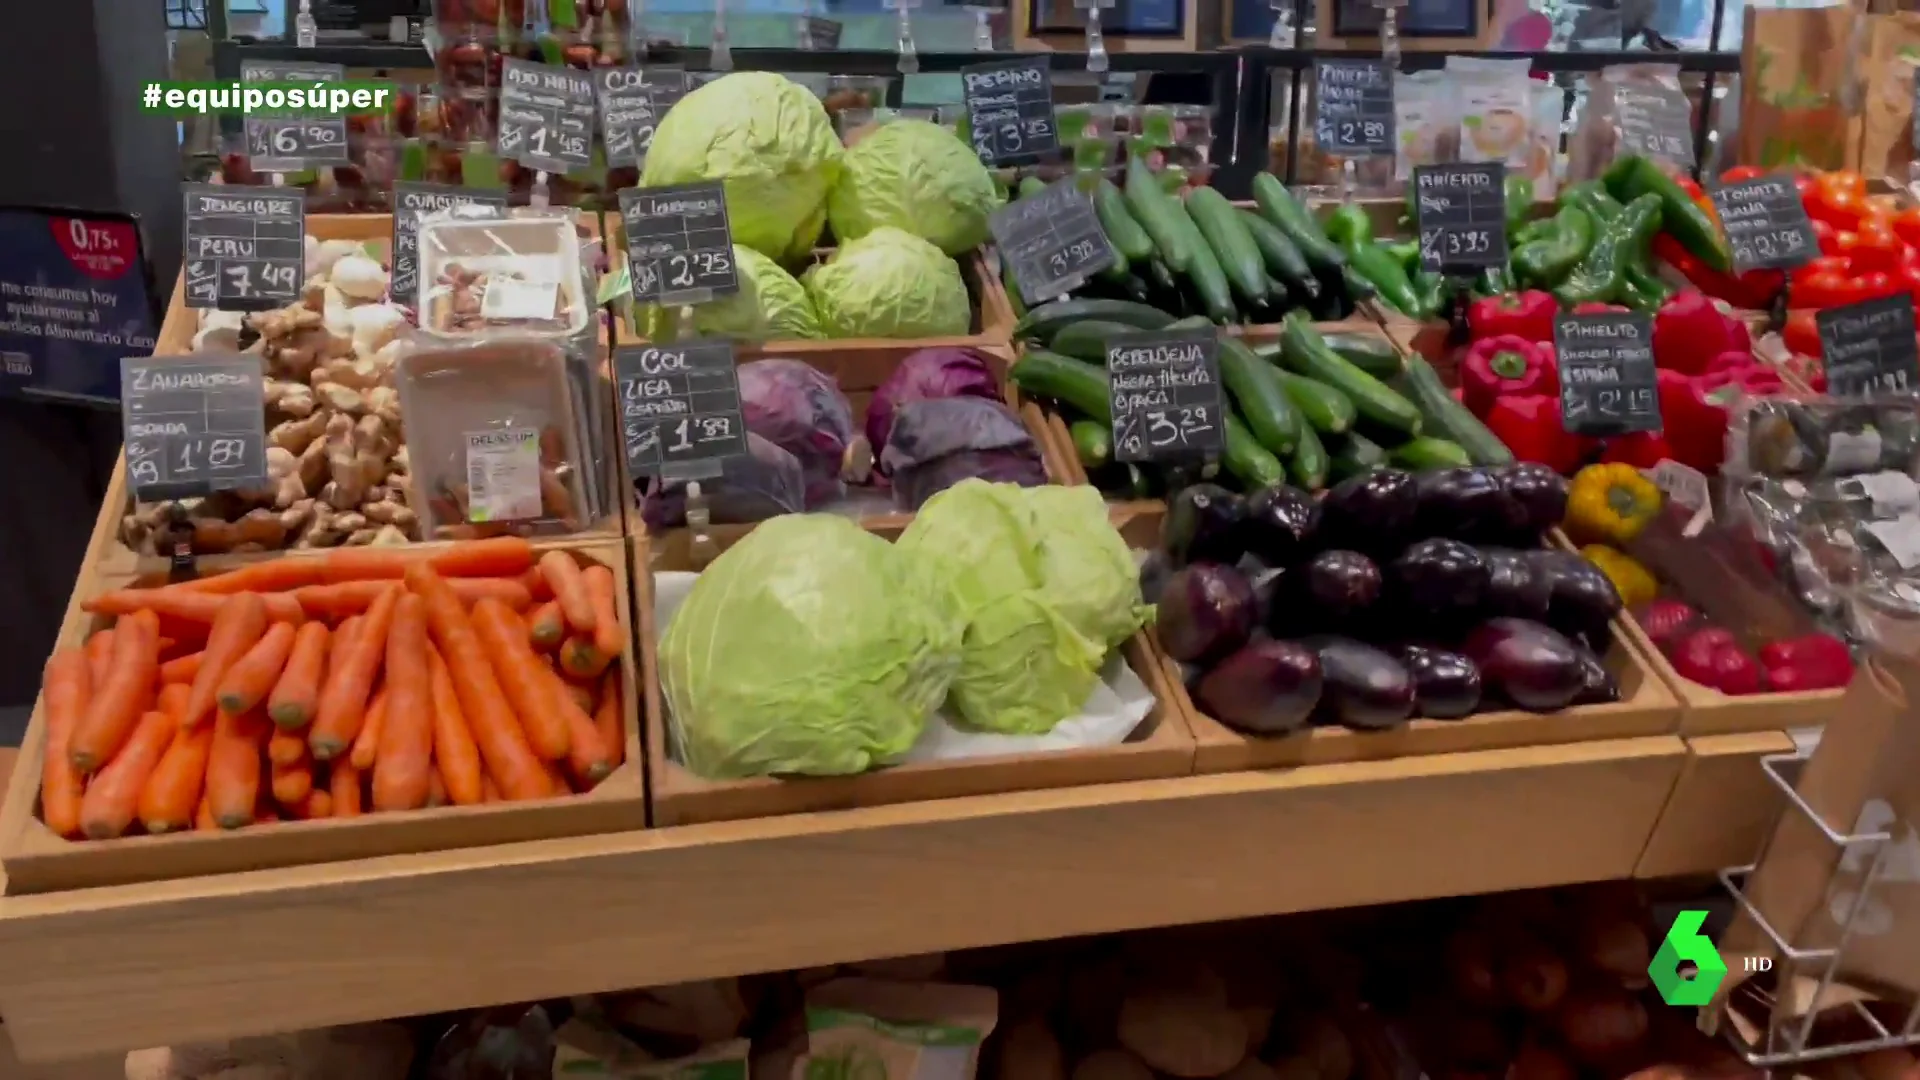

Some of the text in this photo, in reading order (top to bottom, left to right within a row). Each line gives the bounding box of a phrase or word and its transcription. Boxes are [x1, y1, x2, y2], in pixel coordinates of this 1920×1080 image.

[200, 197, 293, 215] JENGIBRE
[91, 287, 118, 308] hoy
[641, 348, 692, 374] COL
